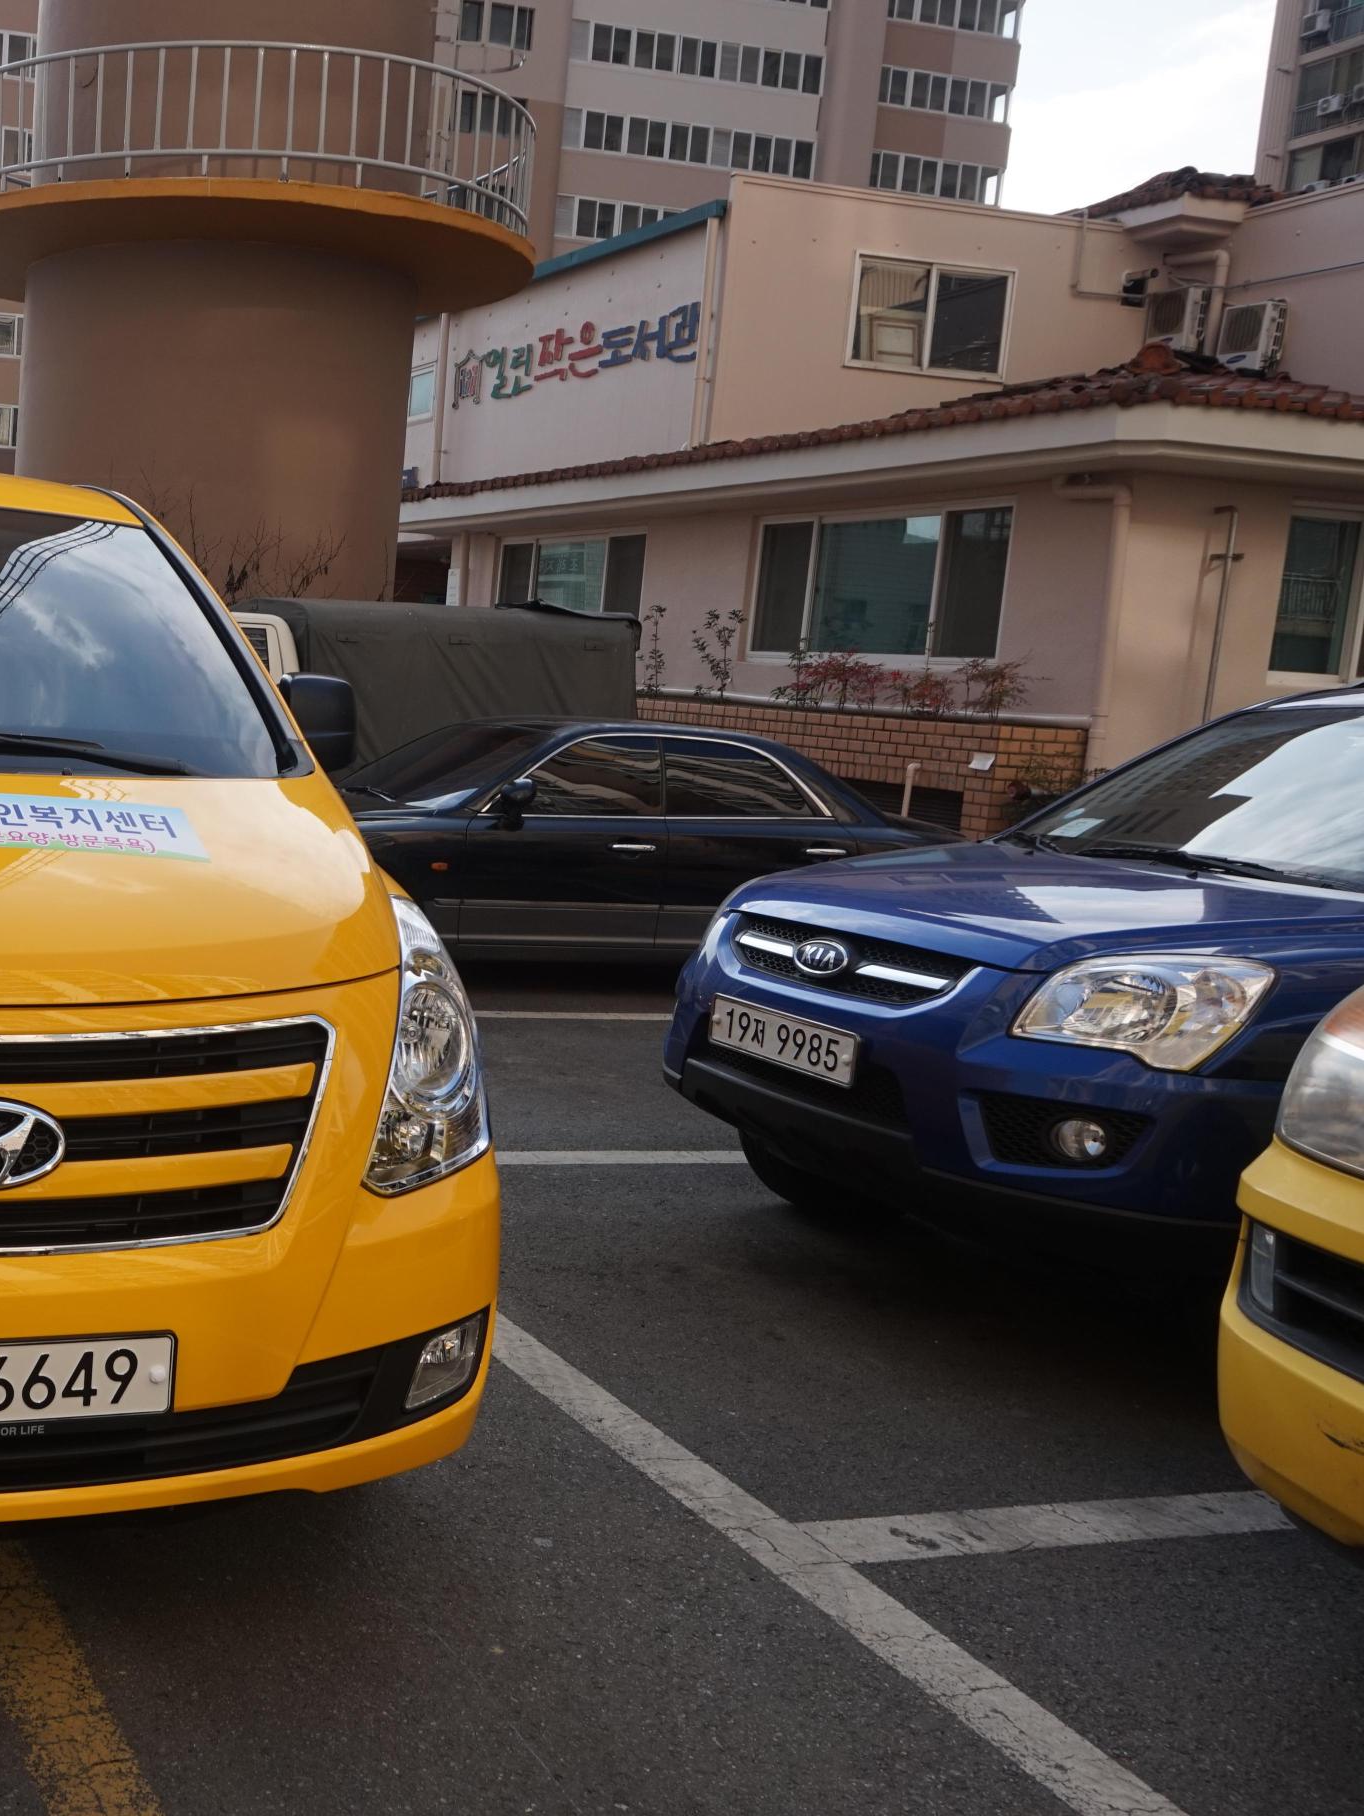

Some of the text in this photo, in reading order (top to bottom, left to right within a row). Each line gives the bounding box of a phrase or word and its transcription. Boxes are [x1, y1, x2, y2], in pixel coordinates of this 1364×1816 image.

[801, 944, 836, 969] KIA
[726, 1008, 839, 1072] 19저 9985
[20, 1425, 44, 1435] LIFE
